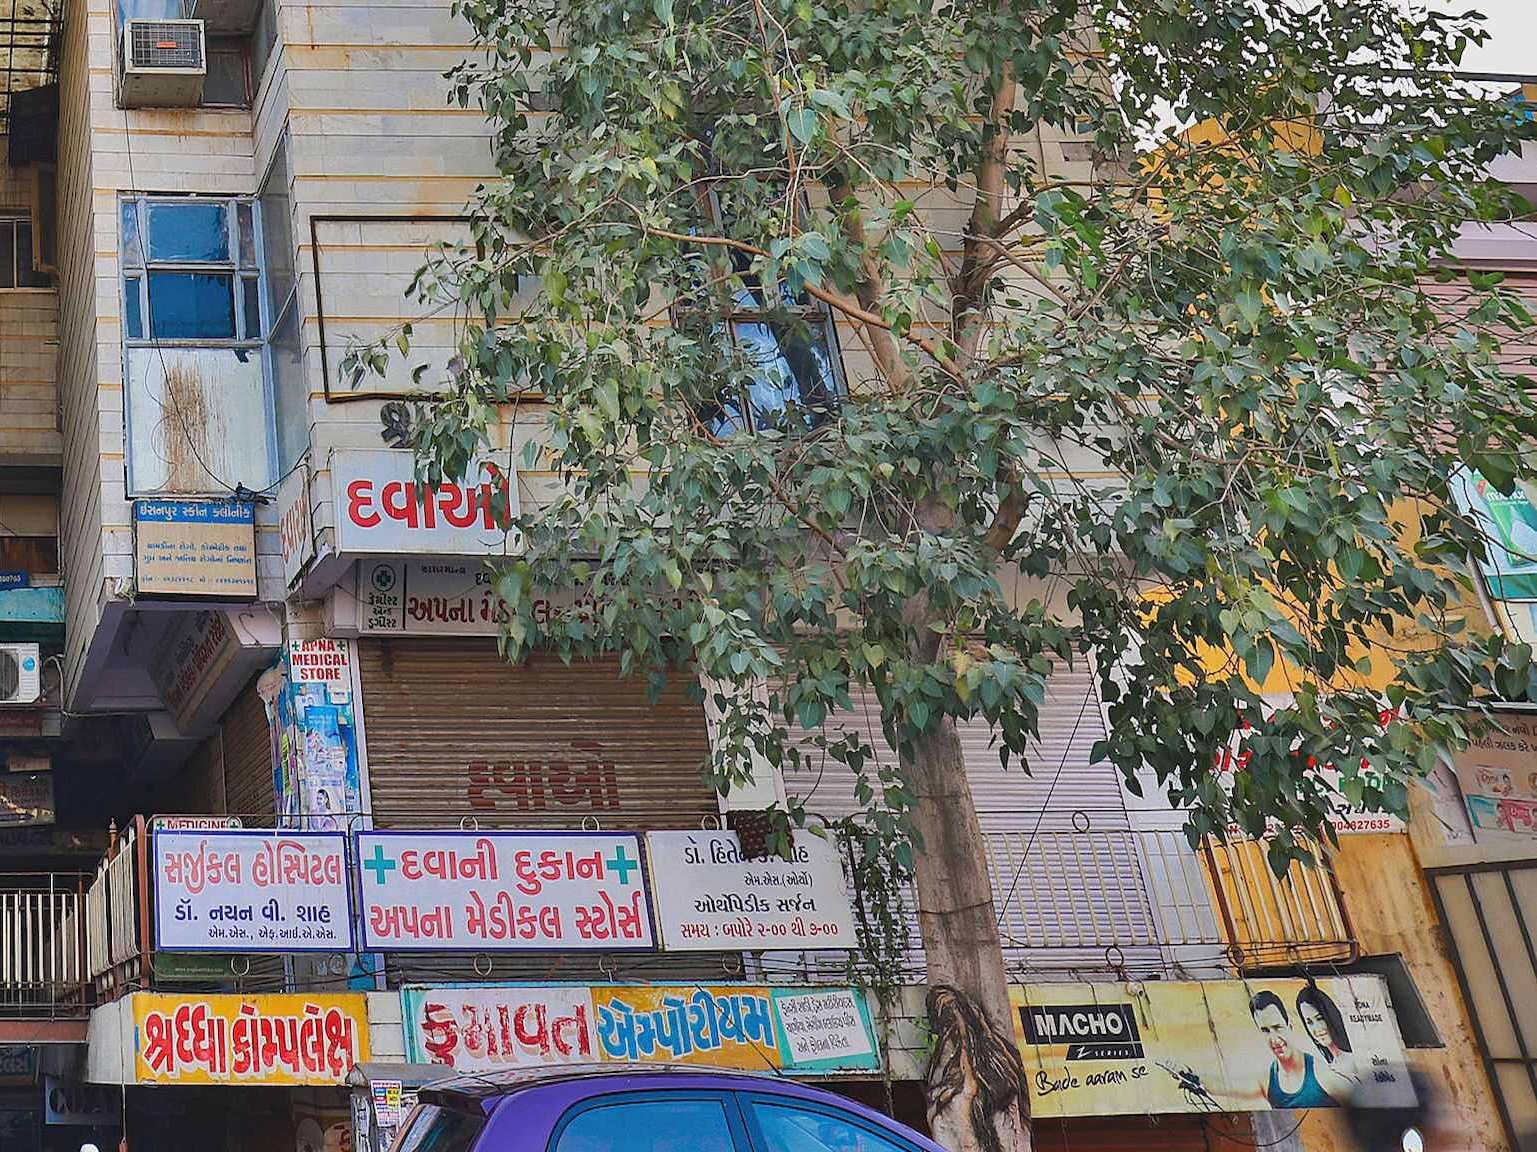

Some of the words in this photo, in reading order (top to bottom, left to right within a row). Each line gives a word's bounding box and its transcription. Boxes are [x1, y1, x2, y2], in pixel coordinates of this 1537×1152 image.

[301, 639, 336, 652] APNA
[291, 652, 348, 667] MEDICAL
[300, 667, 341, 681] STORE
[400, 838, 499, 881] દવાની
[514, 849, 605, 896] દુકાન
[209, 905, 254, 922] નયન
[296, 905, 331, 924] શાહ
[369, 904, 461, 940] અપના
[1034, 1012, 1124, 1036] MACHO
